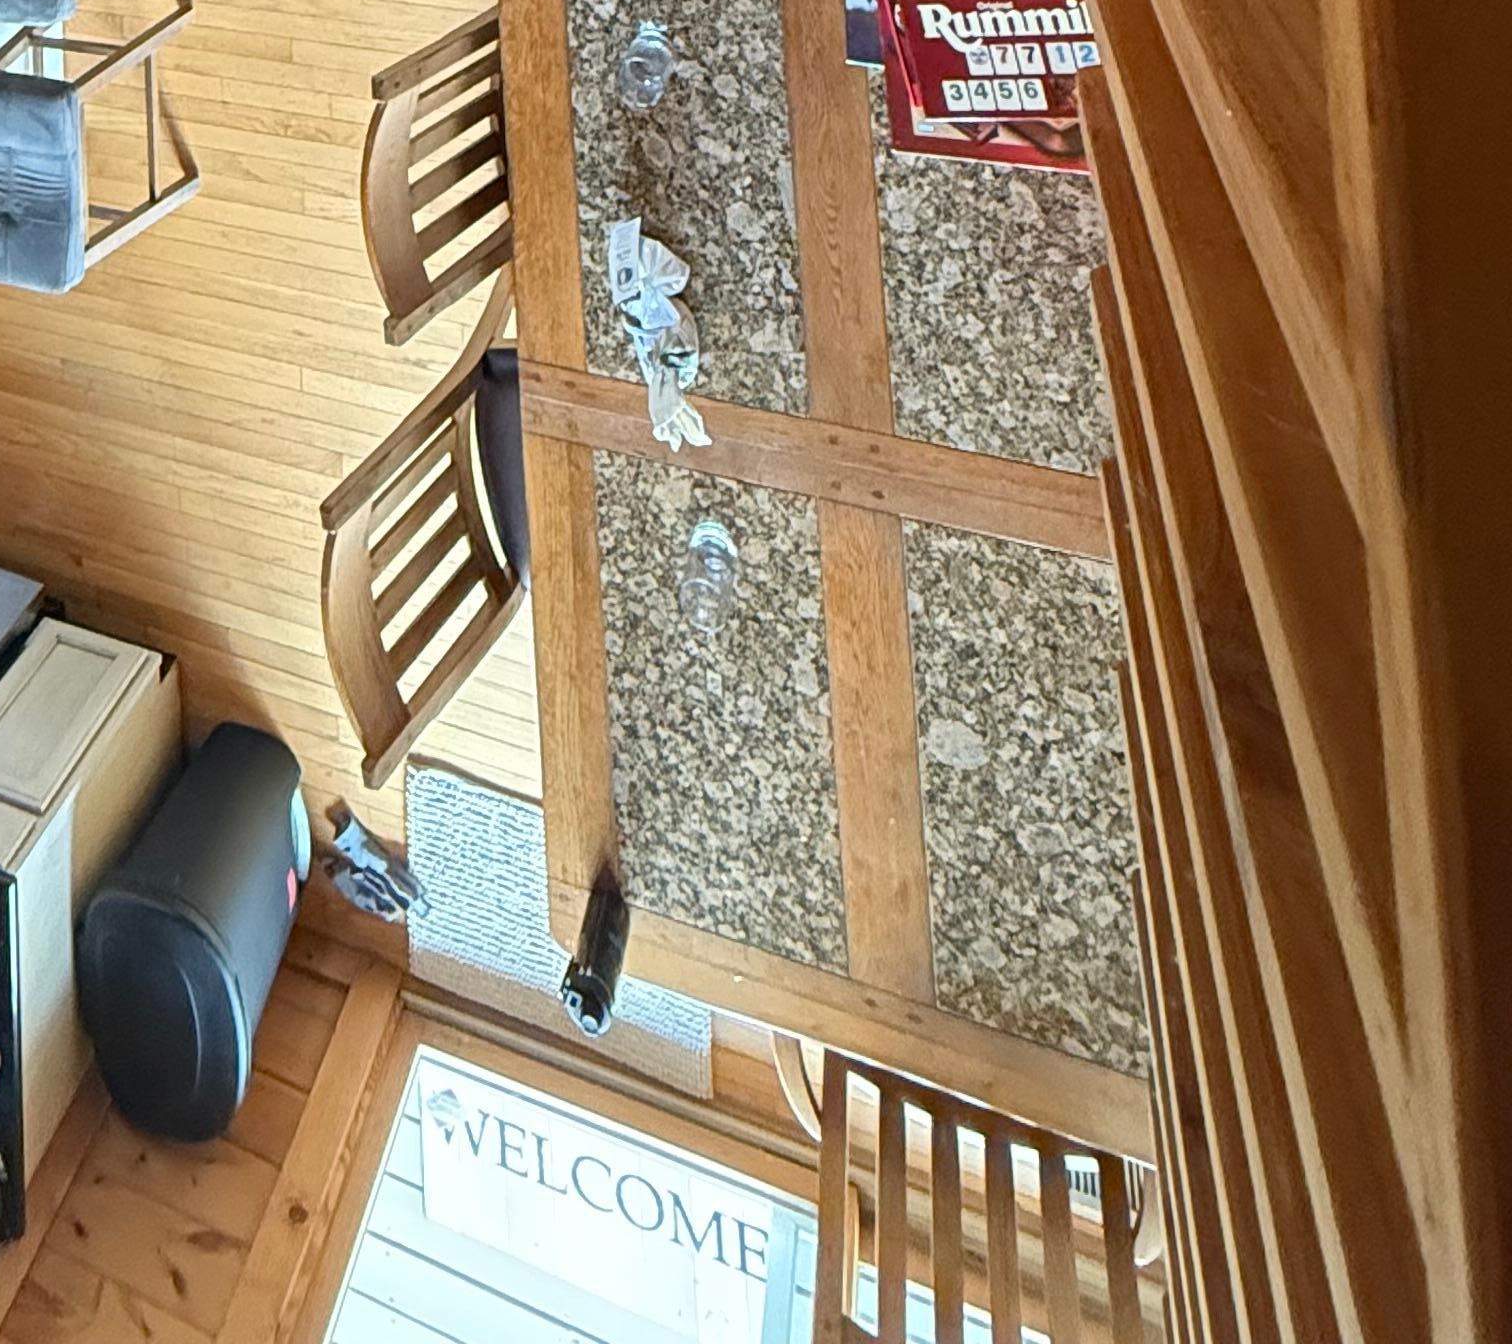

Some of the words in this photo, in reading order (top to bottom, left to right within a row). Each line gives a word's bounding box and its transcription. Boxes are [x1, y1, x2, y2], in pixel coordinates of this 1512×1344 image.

[996, 46, 1009, 64] 7
[1022, 45, 1036, 64] 7
[1054, 44, 1066, 63] 1
[1078, 43, 1096, 63] 2
[949, 83, 964, 101] 3
[973, 83, 989, 100] 4
[998, 83, 1013, 100] 5
[1023, 82, 1039, 99] 6
[436, 1106, 769, 1284] WELCOME
